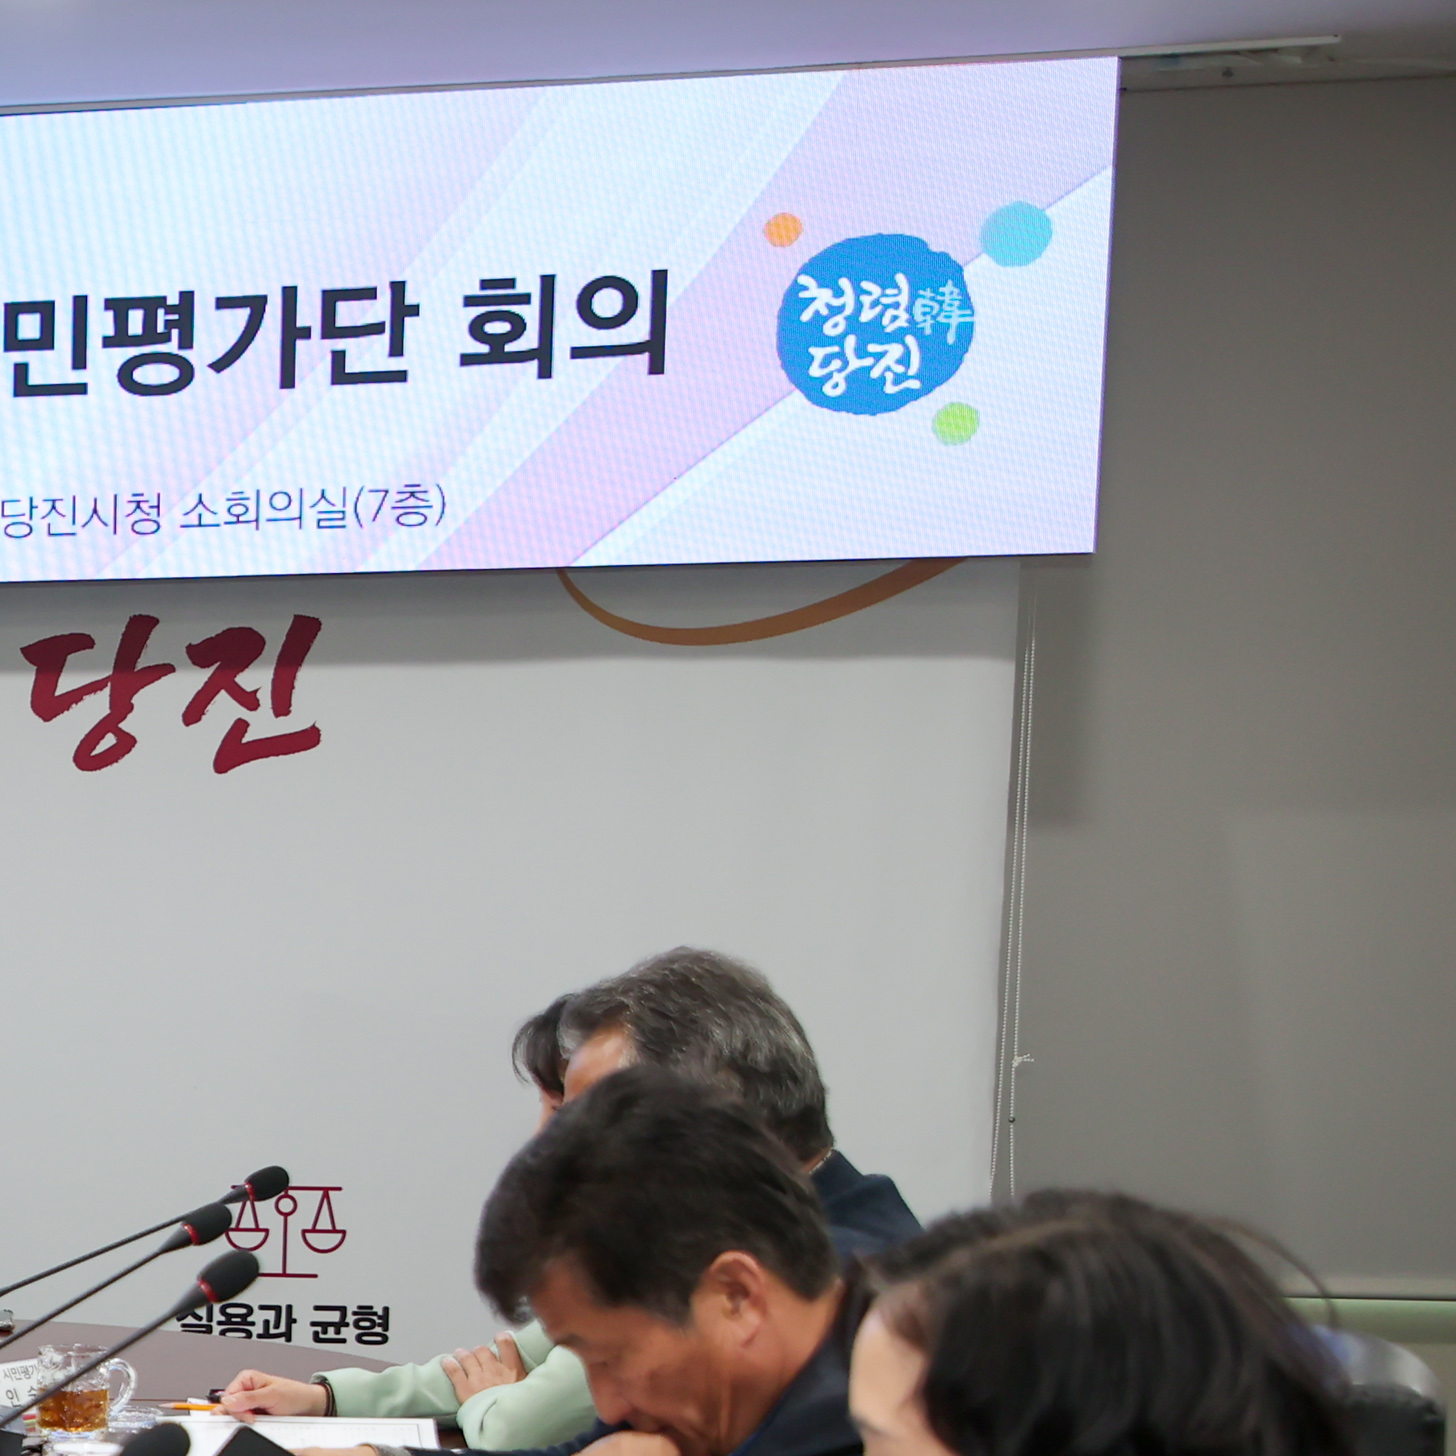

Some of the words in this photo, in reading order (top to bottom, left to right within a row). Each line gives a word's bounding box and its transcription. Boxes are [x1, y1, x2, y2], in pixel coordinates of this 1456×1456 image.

[459, 268, 669, 380] 회의
[808, 333, 921, 397] 당진
[0, 491, 162, 540] 당진시청
[179, 483, 447, 532] 소회의실(7층)
[19, 613, 322, 776] 당진
[309, 1304, 390, 1346] 균형
[3, 1363, 38, 1383] 시민평가
